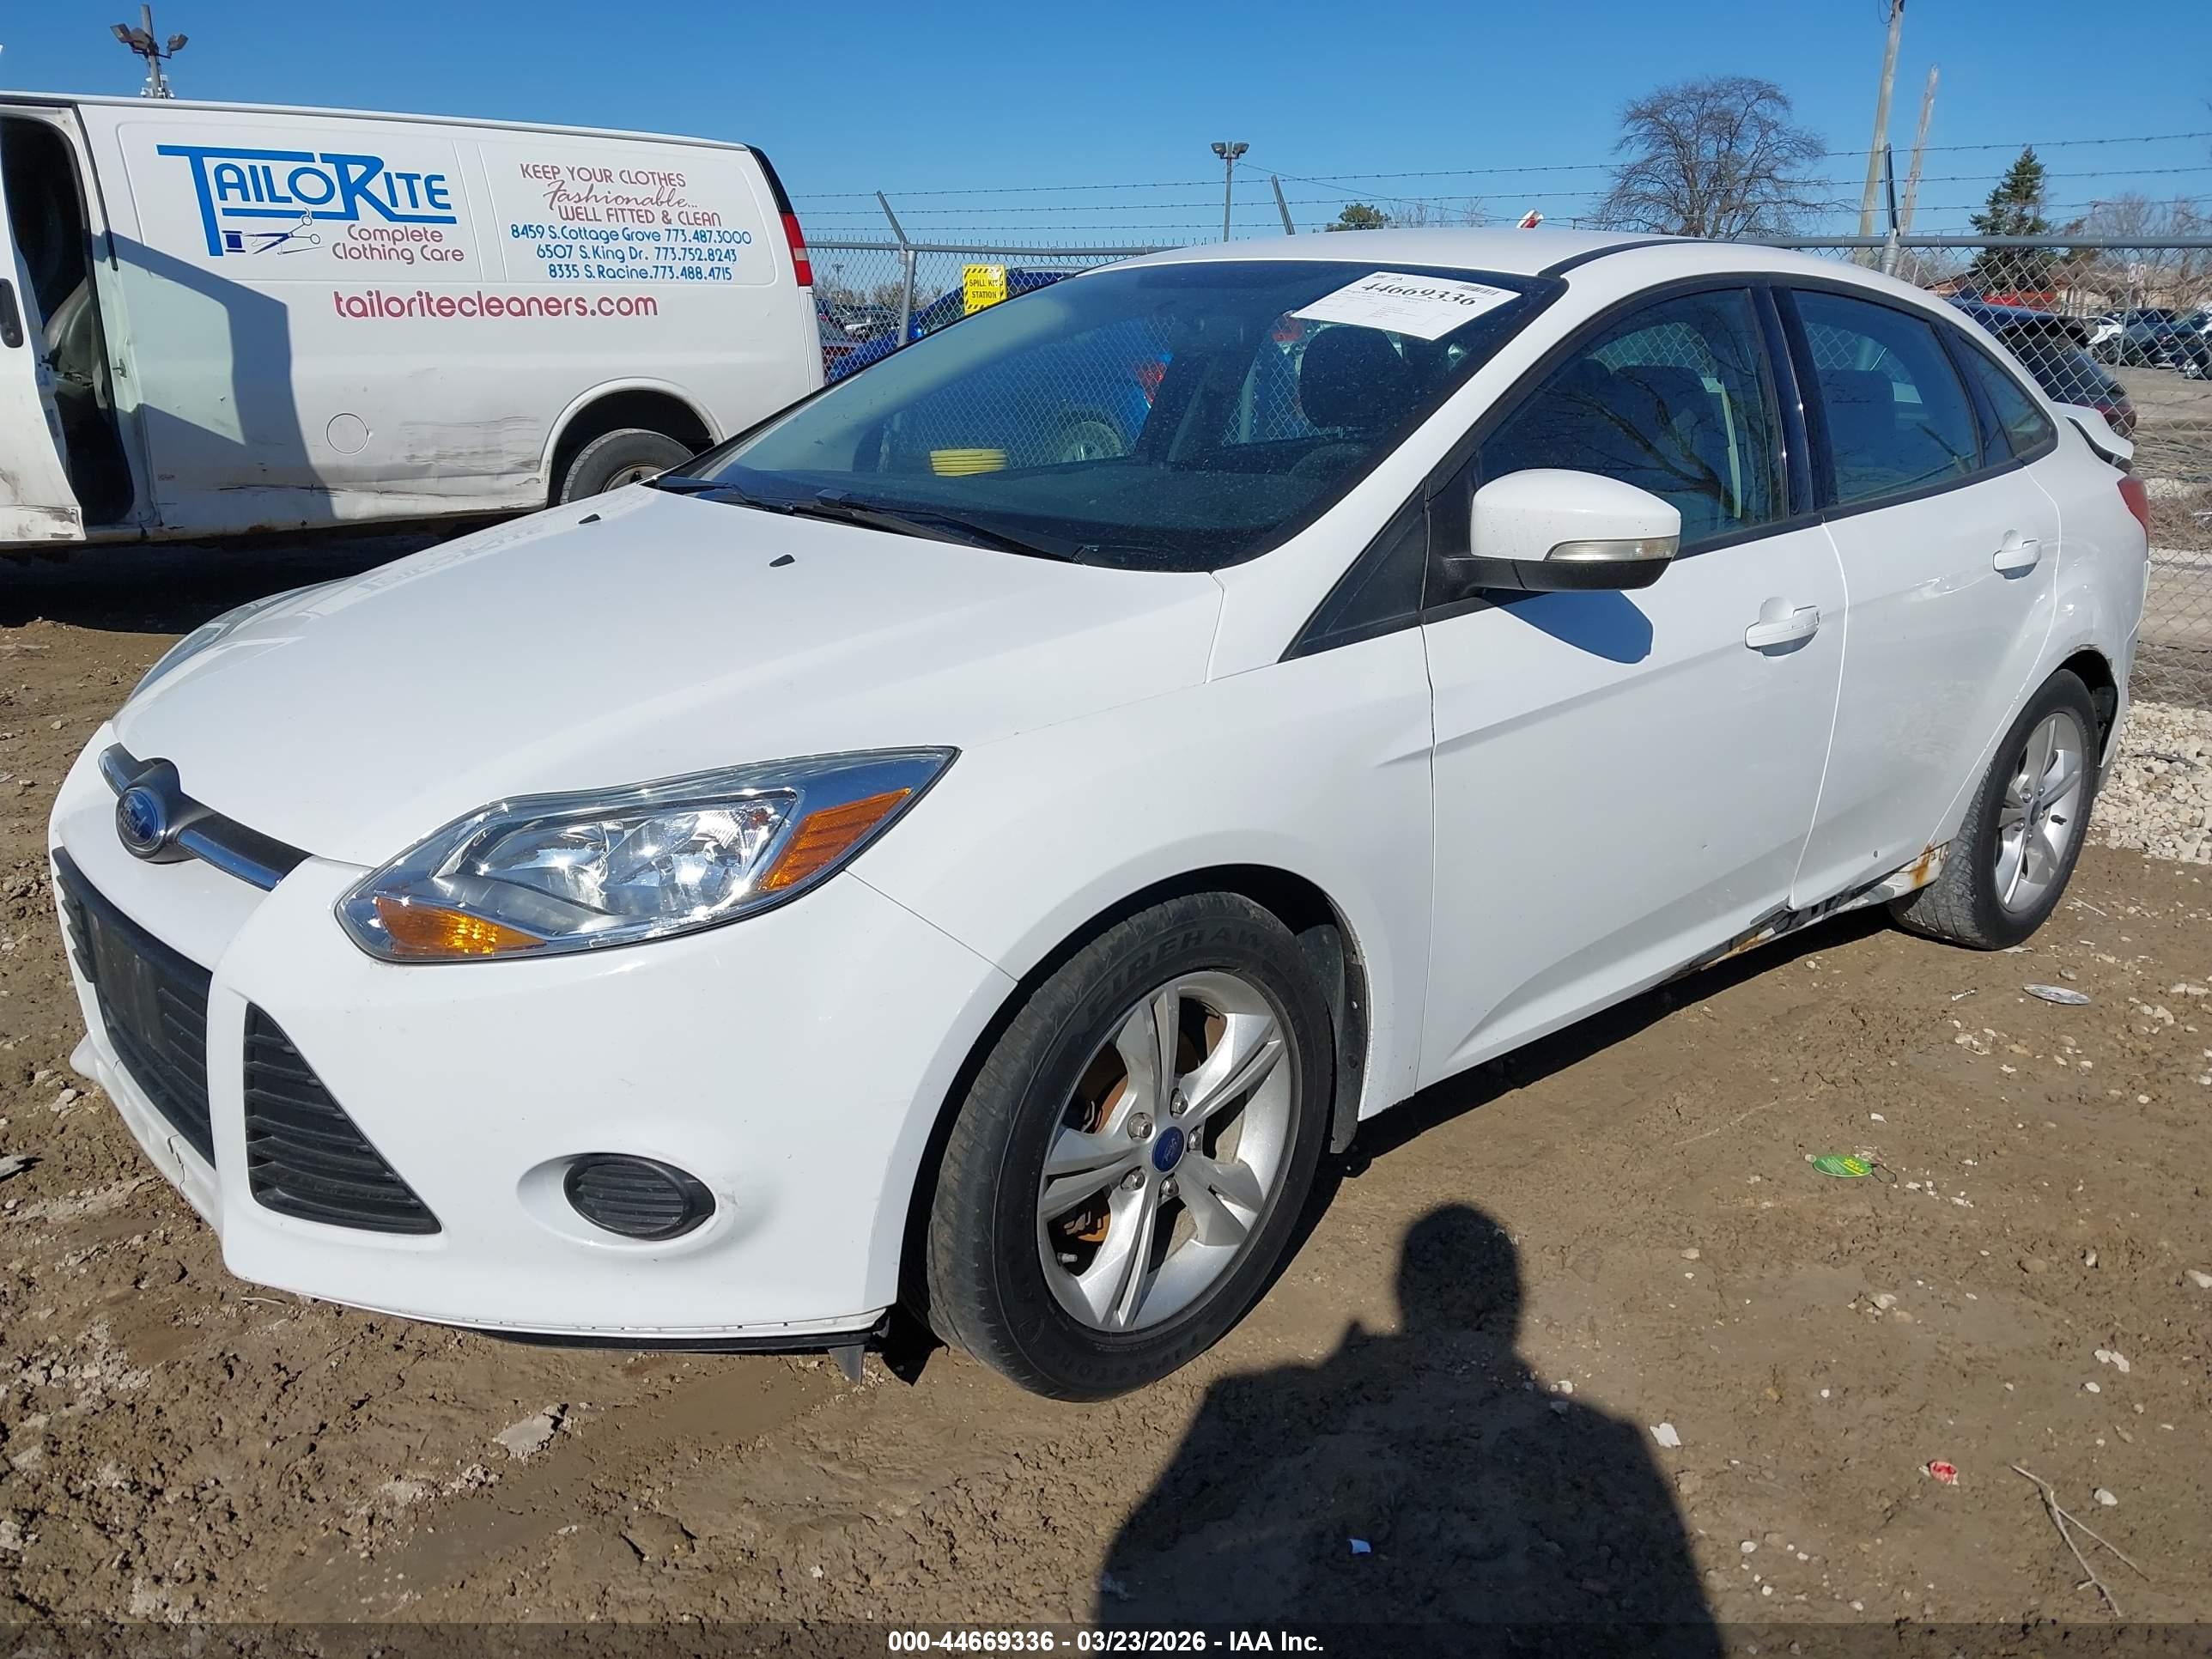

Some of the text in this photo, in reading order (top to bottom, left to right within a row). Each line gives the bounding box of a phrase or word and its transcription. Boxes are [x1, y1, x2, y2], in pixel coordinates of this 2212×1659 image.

[520, 163, 686, 188] KEEP YOUR CLOTHES
[557, 205, 722, 227] WELL FITTED & CLEAN
[347, 223, 443, 246] Complete
[510, 223, 544, 239] 8459
[622, 227, 661, 242] Grove
[665, 228, 752, 245] 773.487.3000
[331, 242, 465, 265] Clothing Care
[537, 244, 573, 258] 6507
[629, 246, 648, 260] Dr.
[654, 246, 737, 262] 773.752.8243
[549, 264, 580, 278] 8335
[969, 278, 988, 288] SPILL
[333, 289, 658, 318] tailoritecleaners.com
[971, 290, 997, 299] STATION
[1362, 282, 1480, 307] 44669336
